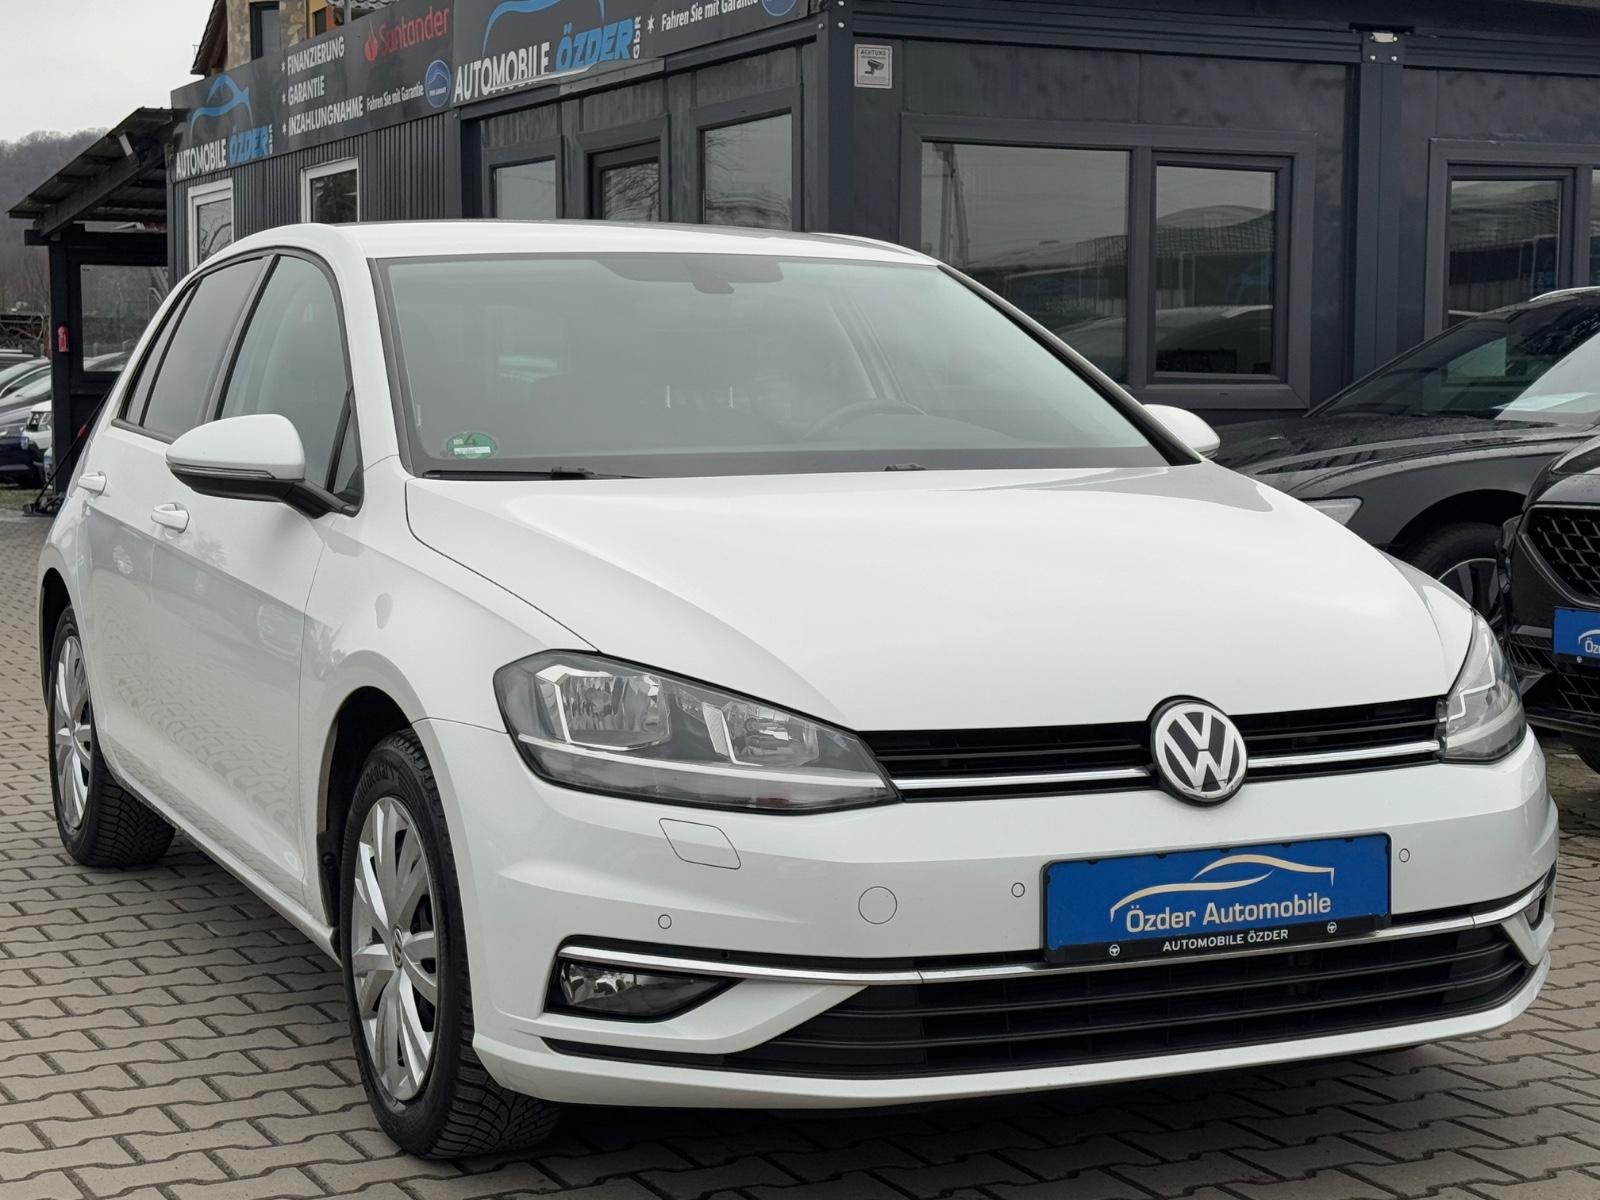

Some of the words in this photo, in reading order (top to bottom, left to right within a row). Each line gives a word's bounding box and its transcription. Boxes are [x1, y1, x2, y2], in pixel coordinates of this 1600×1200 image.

[379, 6, 449, 57] Santander
[661, 10, 689, 31] Fahren
[691, 1, 703, 23] Sie
[704, 0, 720, 19] mit
[288, 36, 344, 76] FINANZIERUNG
[453, 41, 550, 103] AUTOMOBILE
[556, 18, 634, 72] ÖZDER
[633, 16, 641, 59] GbR
[288, 75, 325, 106] GARANTIE
[384, 90, 392, 107] Sie
[288, 96, 363, 137] INZAHLUNGNAHME
[176, 138, 227, 179] AUTOMOBILE
[1585, 637, 1600, 654] Öz
[1126, 905, 1197, 933] Özder
[1202, 892, 1331, 926] Automobile
[1162, 934, 1244, 952] AUTOMOBILE
[1247, 929, 1289, 944] ÖZDER
